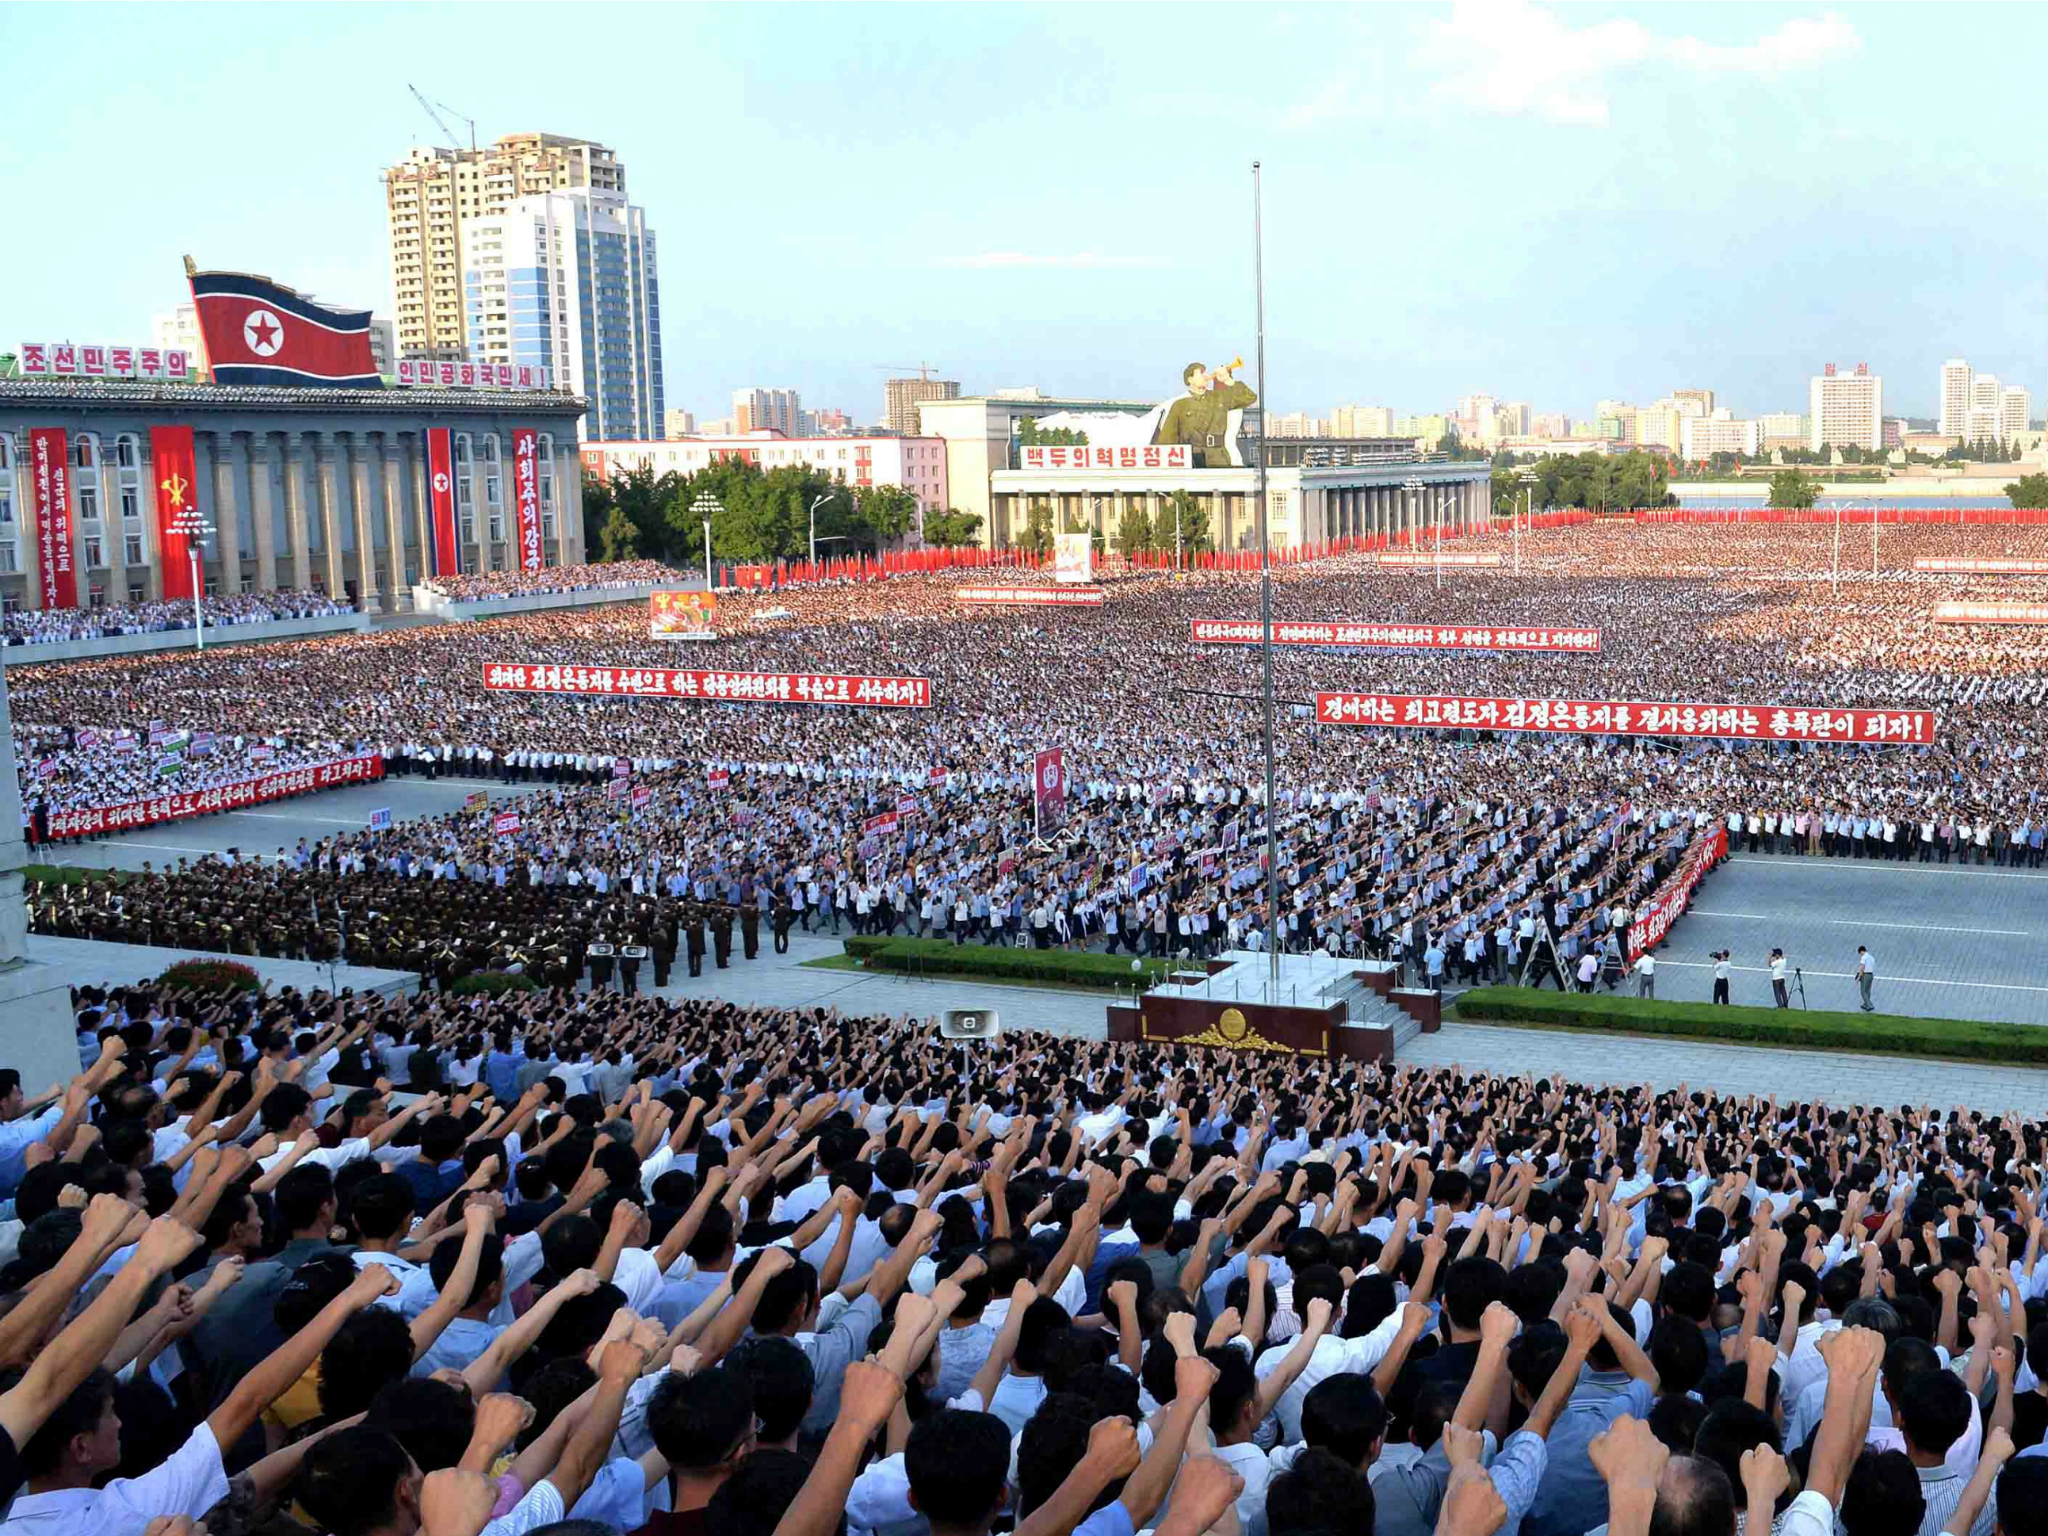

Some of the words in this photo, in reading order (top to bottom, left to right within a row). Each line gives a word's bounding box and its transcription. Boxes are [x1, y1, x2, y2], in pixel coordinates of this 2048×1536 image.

[23, 345, 188, 377] 조선민주주의
[488, 665, 527, 689] 위대한
[530, 665, 614, 693] 김정은동지를
[702, 673, 791, 700] 당중앙위원회를
[795, 676, 850, 701] 목숨으로
[855, 678, 924, 705] 사수하자!
[1322, 696, 1397, 722] 경애하는
[1403, 699, 1499, 726] 최고령도자
[1500, 699, 1632, 731] 김정은동지를
[1636, 705, 1761, 736] 결사옹위하는
[1767, 710, 1855, 739] 총폭탄이
[1863, 714, 1924, 742] 되자!
[47, 809, 103, 836] 력자강의
[107, 800, 146, 827] 위대한
